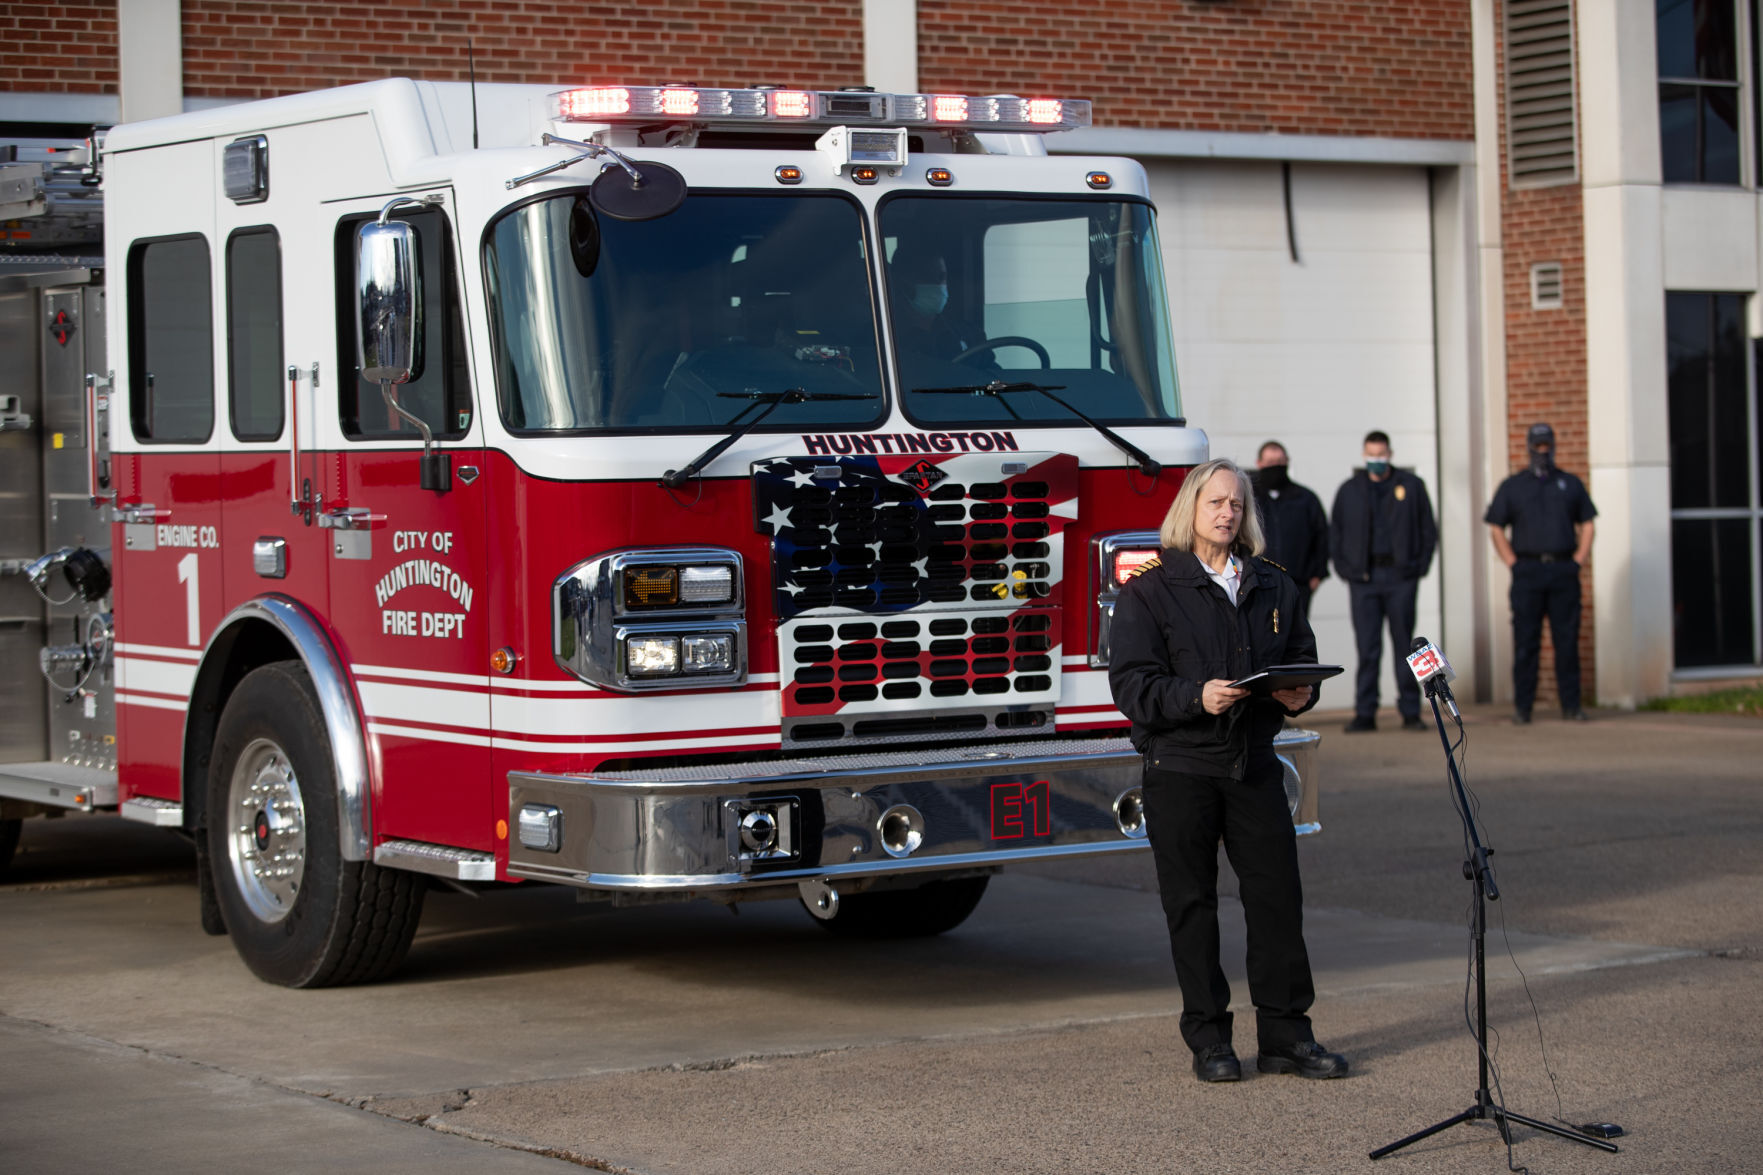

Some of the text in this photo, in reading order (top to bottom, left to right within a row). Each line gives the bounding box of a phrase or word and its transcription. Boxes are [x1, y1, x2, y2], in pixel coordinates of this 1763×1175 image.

[801, 431, 1019, 455] HUNTINGTON
[157, 524, 220, 549] ENGINE CO.
[393, 530, 453, 554] CITY OF
[177, 552, 200, 647] 1
[375, 559, 473, 613] HUNTINGTON
[382, 609, 466, 639] FIRE DEPT
[1412, 649, 1440, 677] 3
[990, 780, 1050, 840] E1
